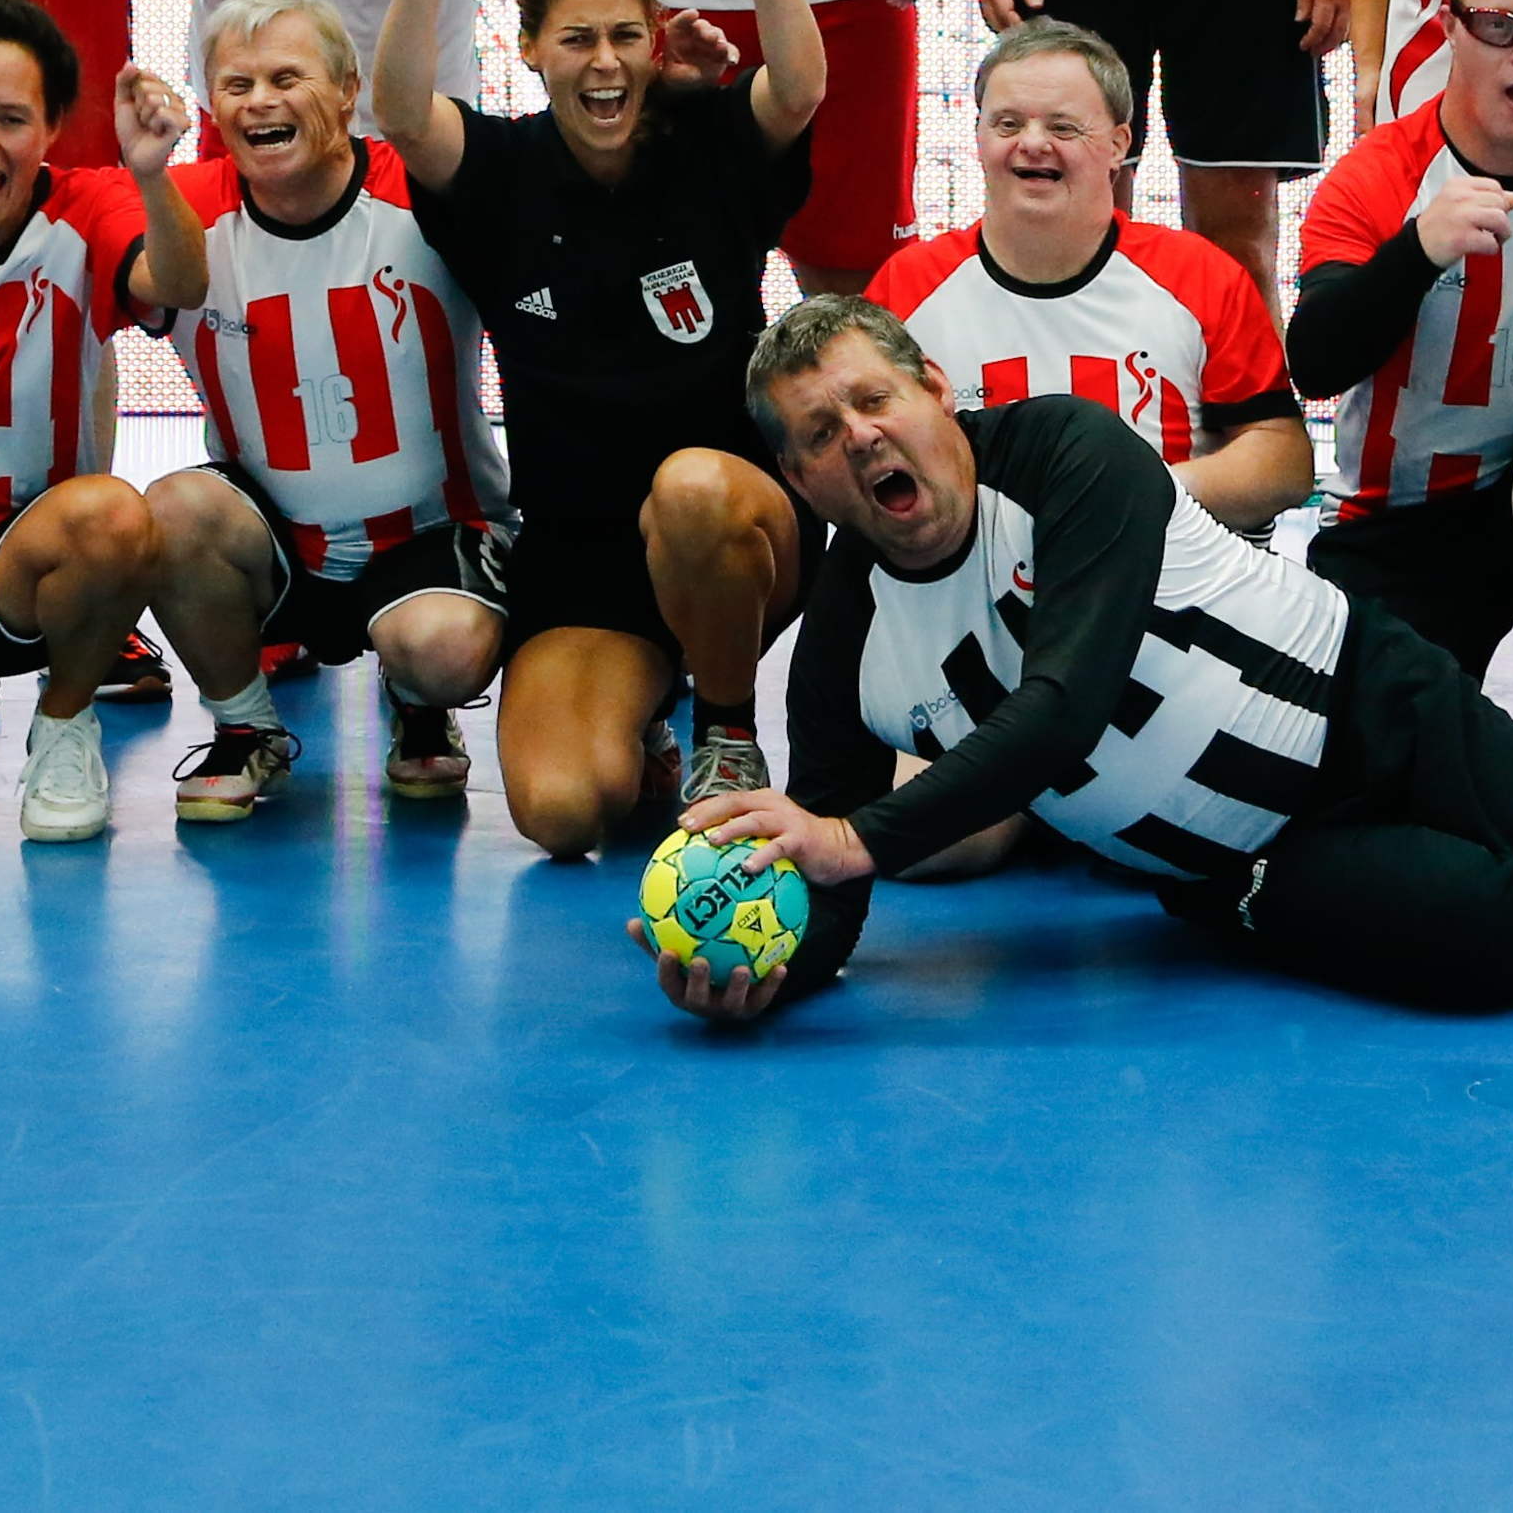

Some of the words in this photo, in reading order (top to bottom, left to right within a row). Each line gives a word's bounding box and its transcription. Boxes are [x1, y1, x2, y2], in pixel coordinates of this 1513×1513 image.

[515, 299, 558, 321] adidas
[292, 373, 360, 446] 16
[684, 862, 767, 932] ELECT
